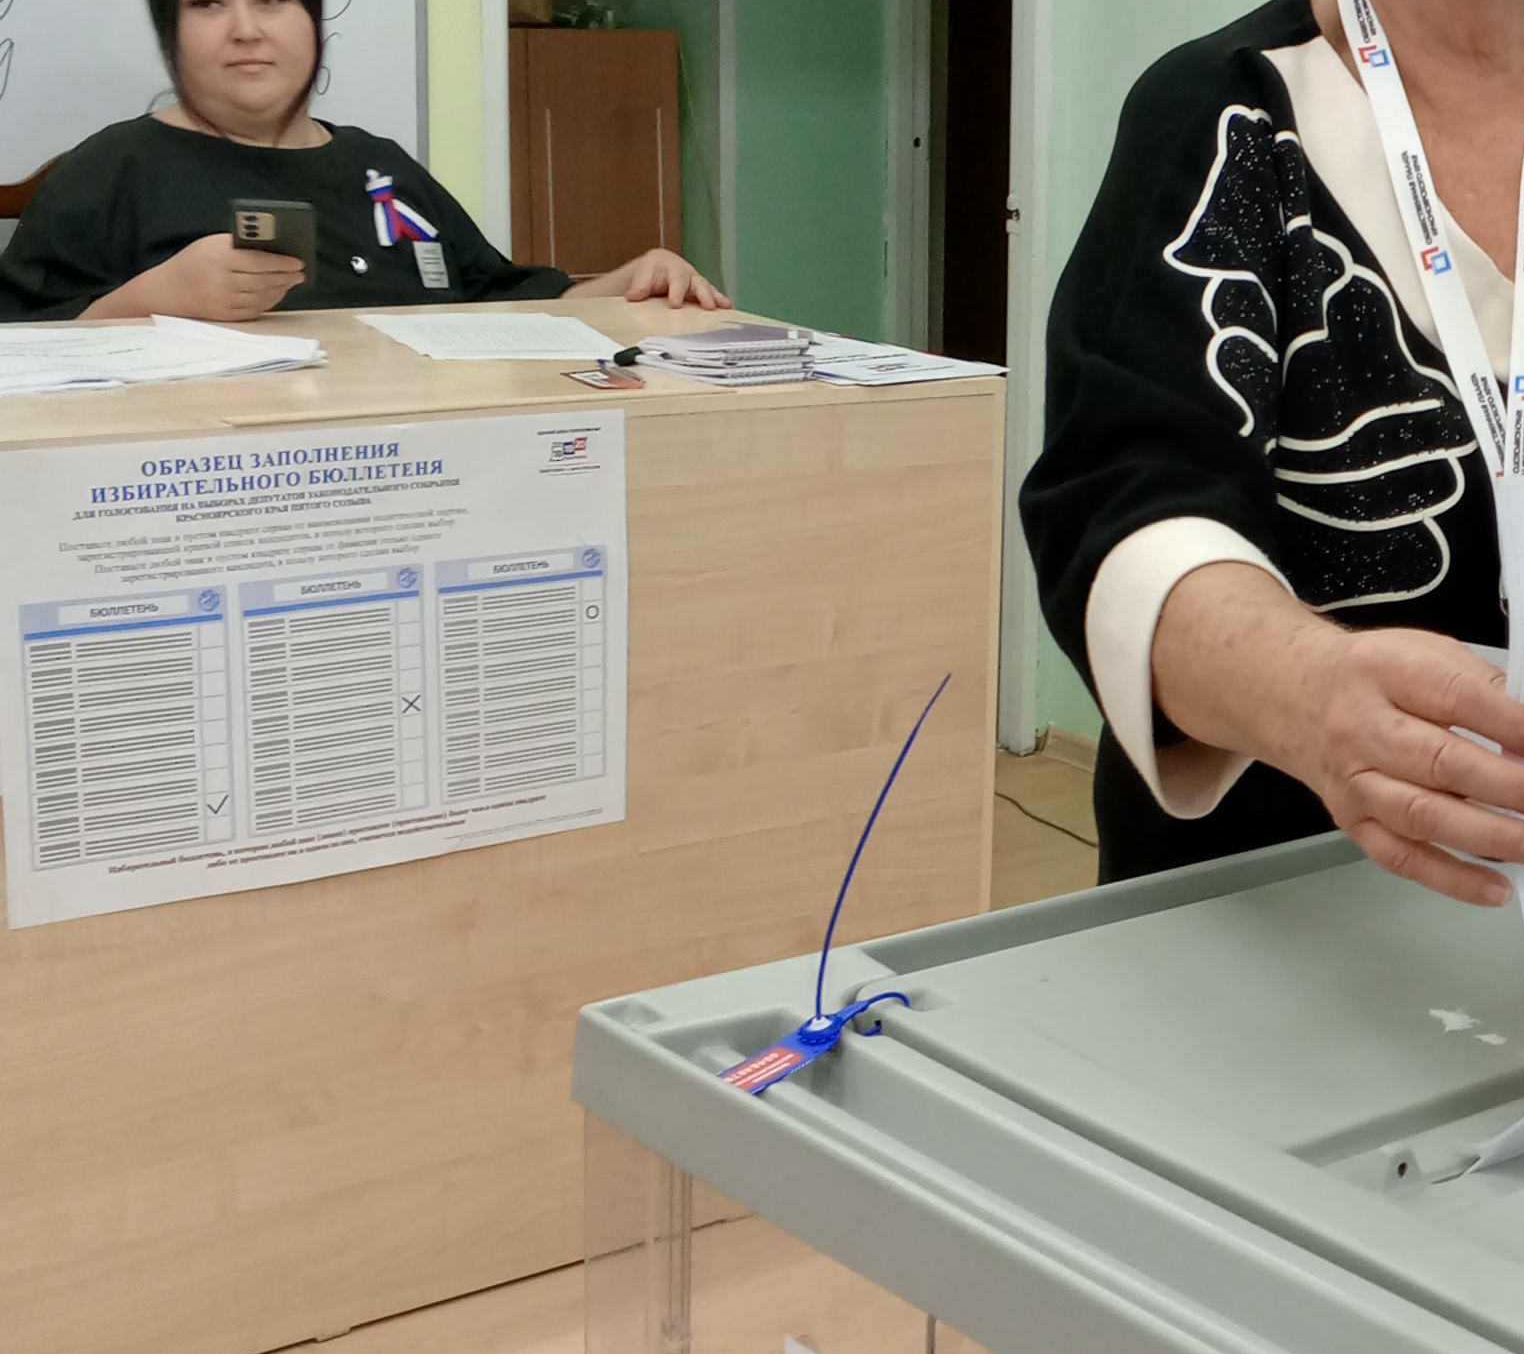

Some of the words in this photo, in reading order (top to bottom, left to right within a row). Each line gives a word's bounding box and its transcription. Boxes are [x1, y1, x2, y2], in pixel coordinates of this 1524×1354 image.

[141, 454, 243, 477] ОБРАЗЕЦ
[250, 442, 399, 469] ЗАПОЛНЕНИЯ
[90, 471, 301, 504] ИЗБИРАТЕЛЬНОГО
[309, 459, 443, 485] БЮЛЛЕТЕНЯ
[493, 560, 550, 574] БЮЛЛЕТЕНЬ
[300, 579, 362, 595] БЮЛЛЕТЕНЬ
[89, 602, 159, 619] БЮЛЛЕТЕНЬ
